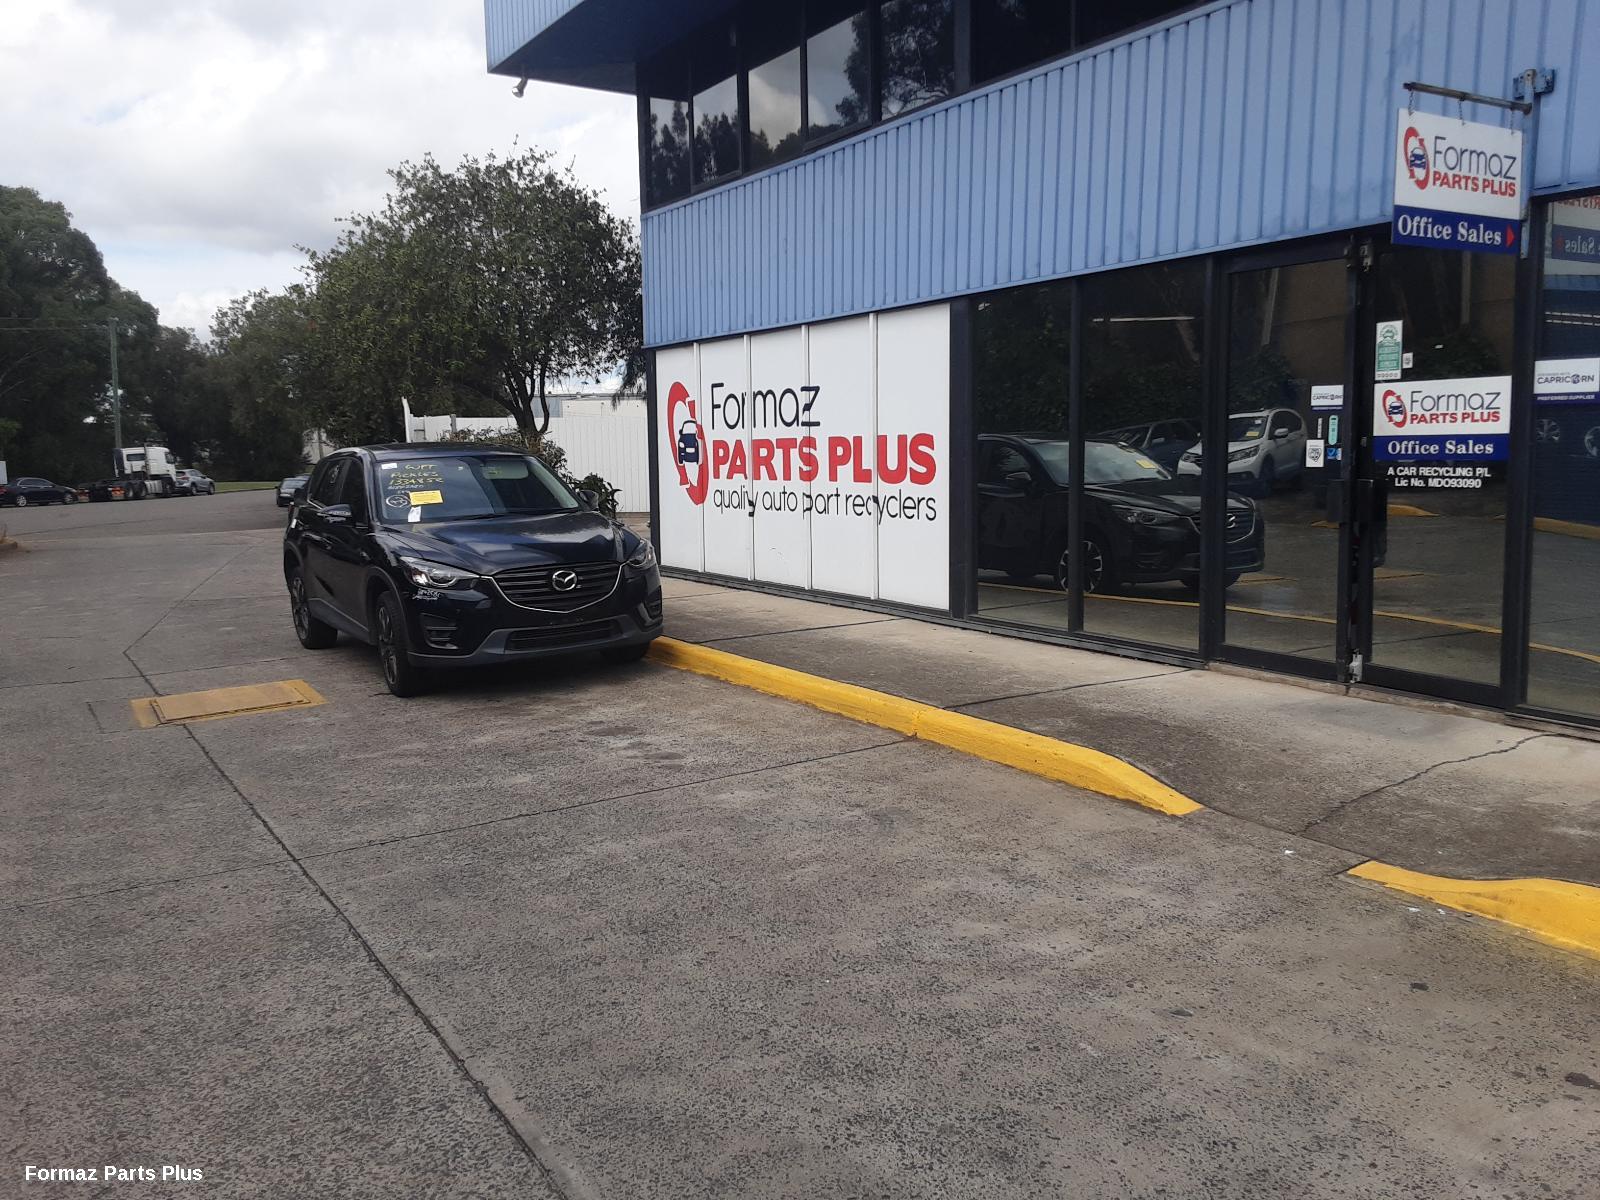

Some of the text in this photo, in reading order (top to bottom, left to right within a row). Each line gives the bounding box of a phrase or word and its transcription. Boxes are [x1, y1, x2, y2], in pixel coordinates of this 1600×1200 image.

[1433, 135, 1517, 181] Formaz
[1432, 170, 1516, 198] PARTS PLUS
[1397, 214, 1502, 246] Office Sales
[711, 382, 821, 430] Formaz
[1409, 390, 1502, 413] Formaz
[1409, 410, 1501, 425] PARTS PLUS
[712, 433, 937, 486] PARTS PLUS
[1387, 439, 1494, 455] Office Sales
[1387, 466, 1492, 477] A CAR RECYCLING P/L
[1394, 478, 1409, 487] Lic
[1410, 478, 1426, 487] No.
[713, 484, 937, 526] qualiy auto part recyclers
